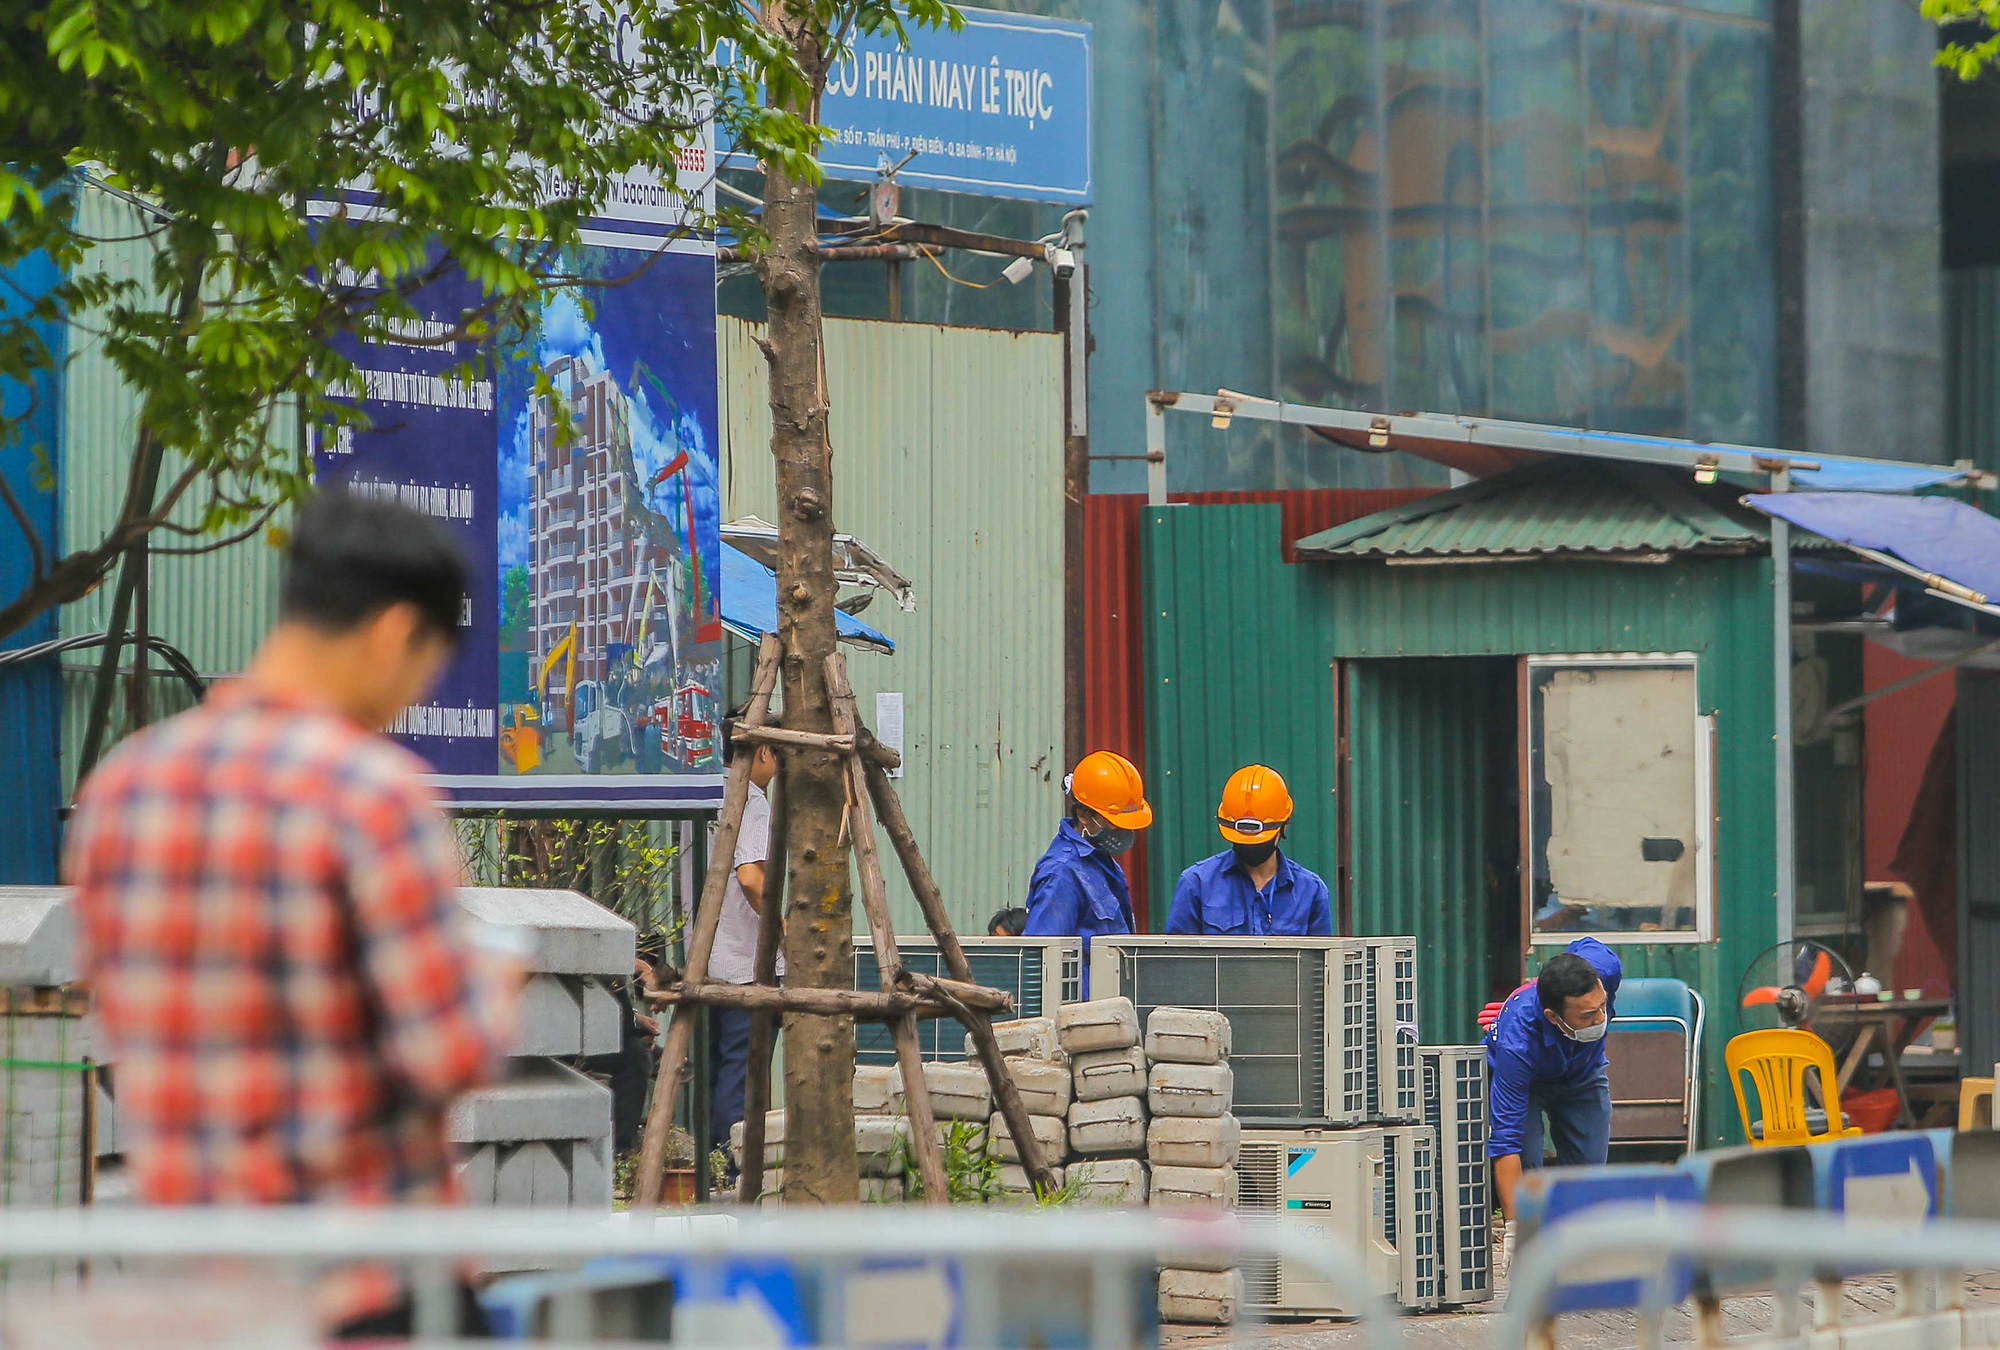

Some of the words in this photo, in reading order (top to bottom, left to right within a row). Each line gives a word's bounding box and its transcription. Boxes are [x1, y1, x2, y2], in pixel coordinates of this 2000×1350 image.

[929, 60, 977, 111] MAY
[981, 54, 1000, 114] LÊ
[1004, 68, 1053, 130] TRỰC
[843, 124, 854, 145] SỐ
[886, 131, 900, 149] PHÚ
[373, 371, 393, 407] PHẠM
[393, 367, 409, 408] TRẬT
[409, 371, 418, 410] TỰ
[418, 369, 430, 405] XÂY
[430, 376, 448, 412] DỰNG
[475, 379, 492, 416] TRỰC
[420, 486, 429, 516] BA
[430, 480, 448, 521] ĐÌNH,
[449, 482, 459, 518] HÀ
[459, 483, 472, 525] NỘI
[408, 703, 427, 741] DỰNG
[427, 701, 442, 736] DÂN
[443, 707, 461, 744] DỤNG
[462, 698, 476, 737] BẮC
[477, 709, 493, 738] NAM
